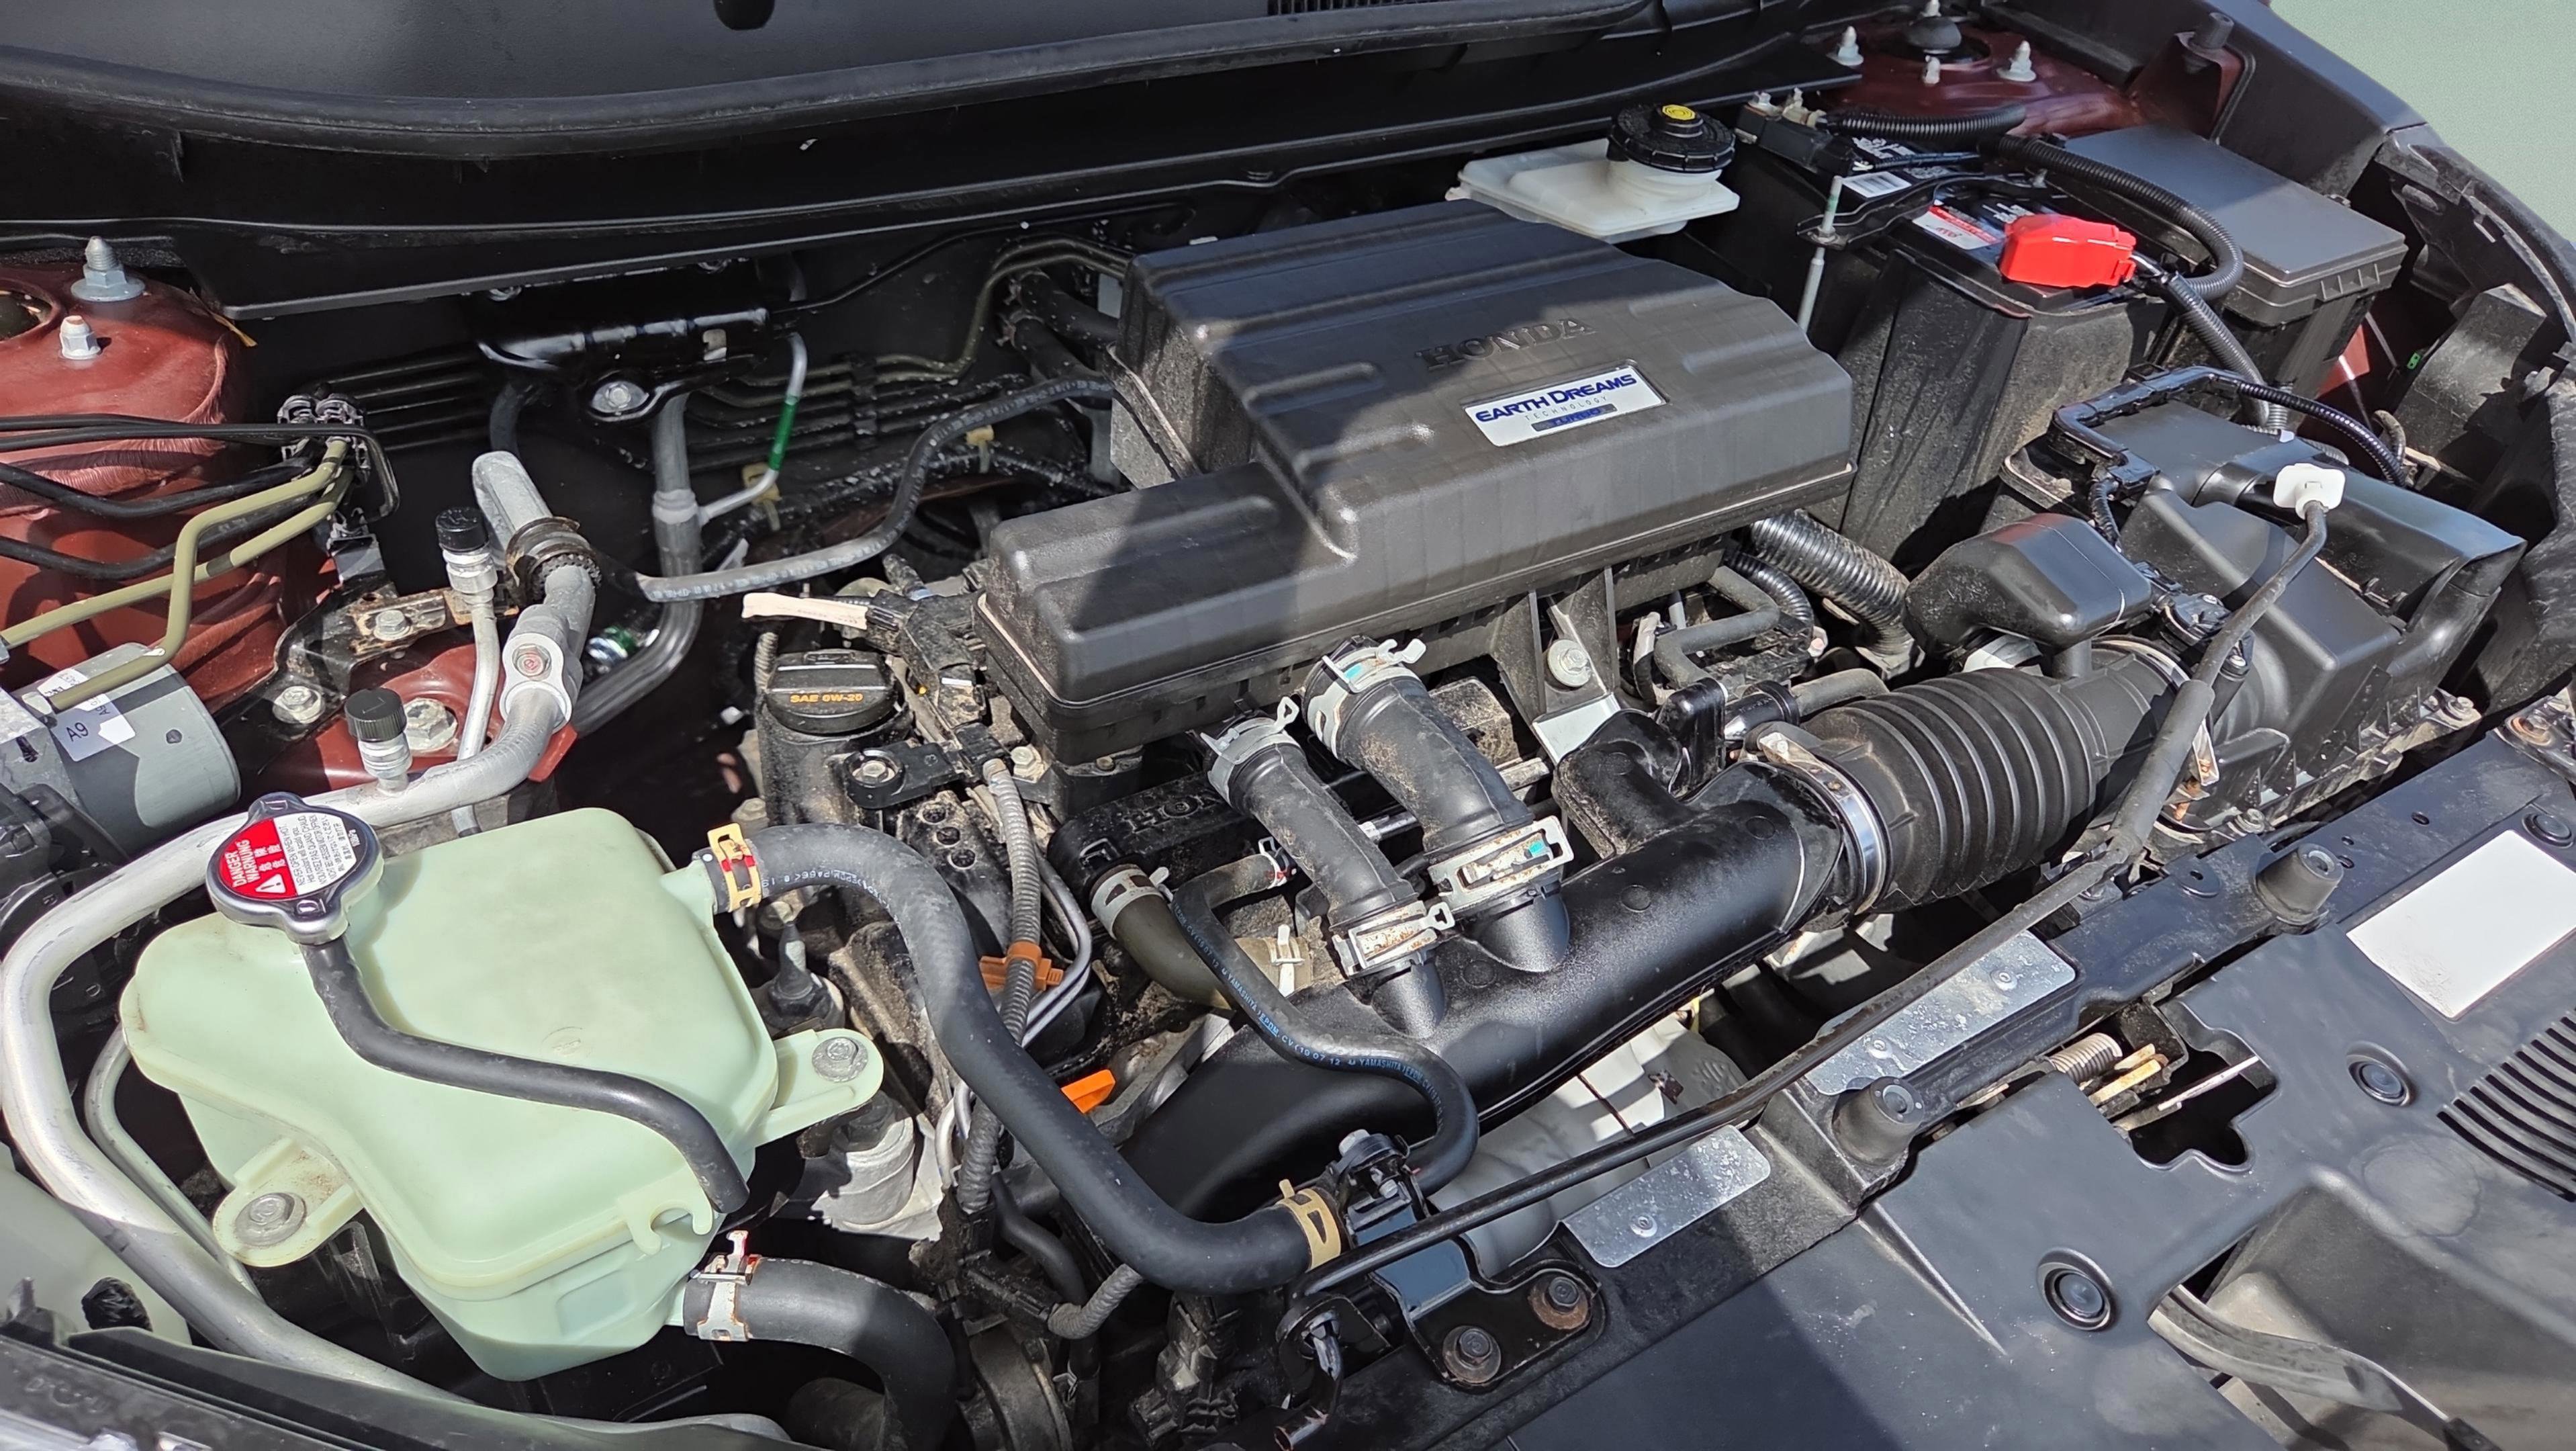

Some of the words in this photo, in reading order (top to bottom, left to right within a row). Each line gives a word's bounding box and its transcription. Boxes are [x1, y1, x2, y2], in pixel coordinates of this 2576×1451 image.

[1415, 318, 1597, 369] HONDA
[1475, 396, 1549, 423] EARTH
[1547, 374, 1637, 404] DREAMS
[1524, 396, 1607, 421] TECHNOLOGY
[790, 694, 819, 703] SAE
[822, 693, 864, 702] 0W-20
[66, 722, 89, 742] A9
[225, 850, 247, 887] DANGER
[235, 840, 261, 883] WARNUNG
[1228, 973, 1258, 1010] YAMASHITA
[1330, 1058, 1341, 1066] 12
[1359, 1057, 1401, 1071] YAMASHITA
